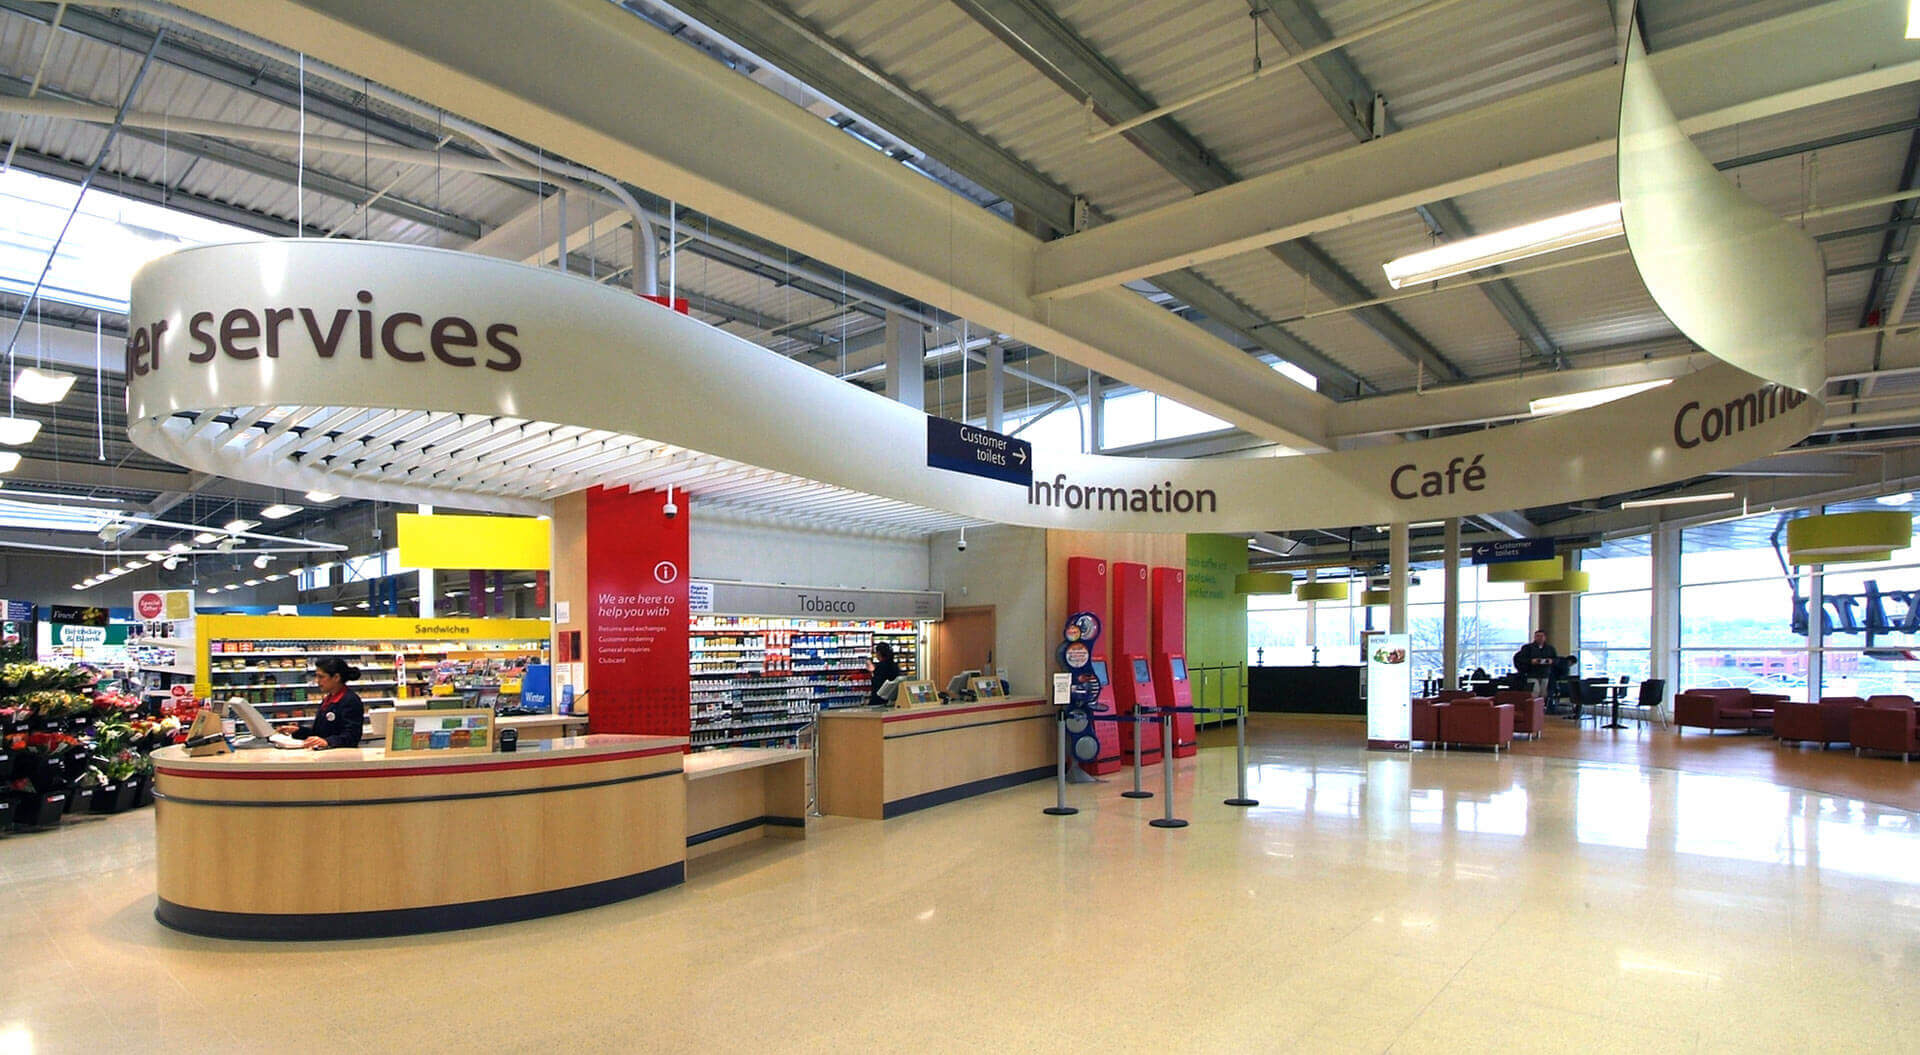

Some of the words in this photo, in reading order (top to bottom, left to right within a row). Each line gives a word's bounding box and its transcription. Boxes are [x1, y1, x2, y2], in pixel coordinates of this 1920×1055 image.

[188, 291, 523, 373] services
[959, 426, 1008, 452] Customer
[976, 447, 1007, 467] toilets
[1390, 454, 1487, 500] Café
[1494, 541, 1532, 550] Customer
[1495, 549, 1519, 557] toilets
[598, 593, 616, 604] We
[618, 596, 635, 604] are
[637, 594, 662, 604] here
[664, 595, 675, 604] to
[797, 594, 856, 614] Tobacco
[598, 606, 622, 619] help
[622, 608, 645, 619] you
[646, 606, 670, 616] with
[414, 624, 470, 634] Sandwiches
[525, 691, 545, 702] Winter
